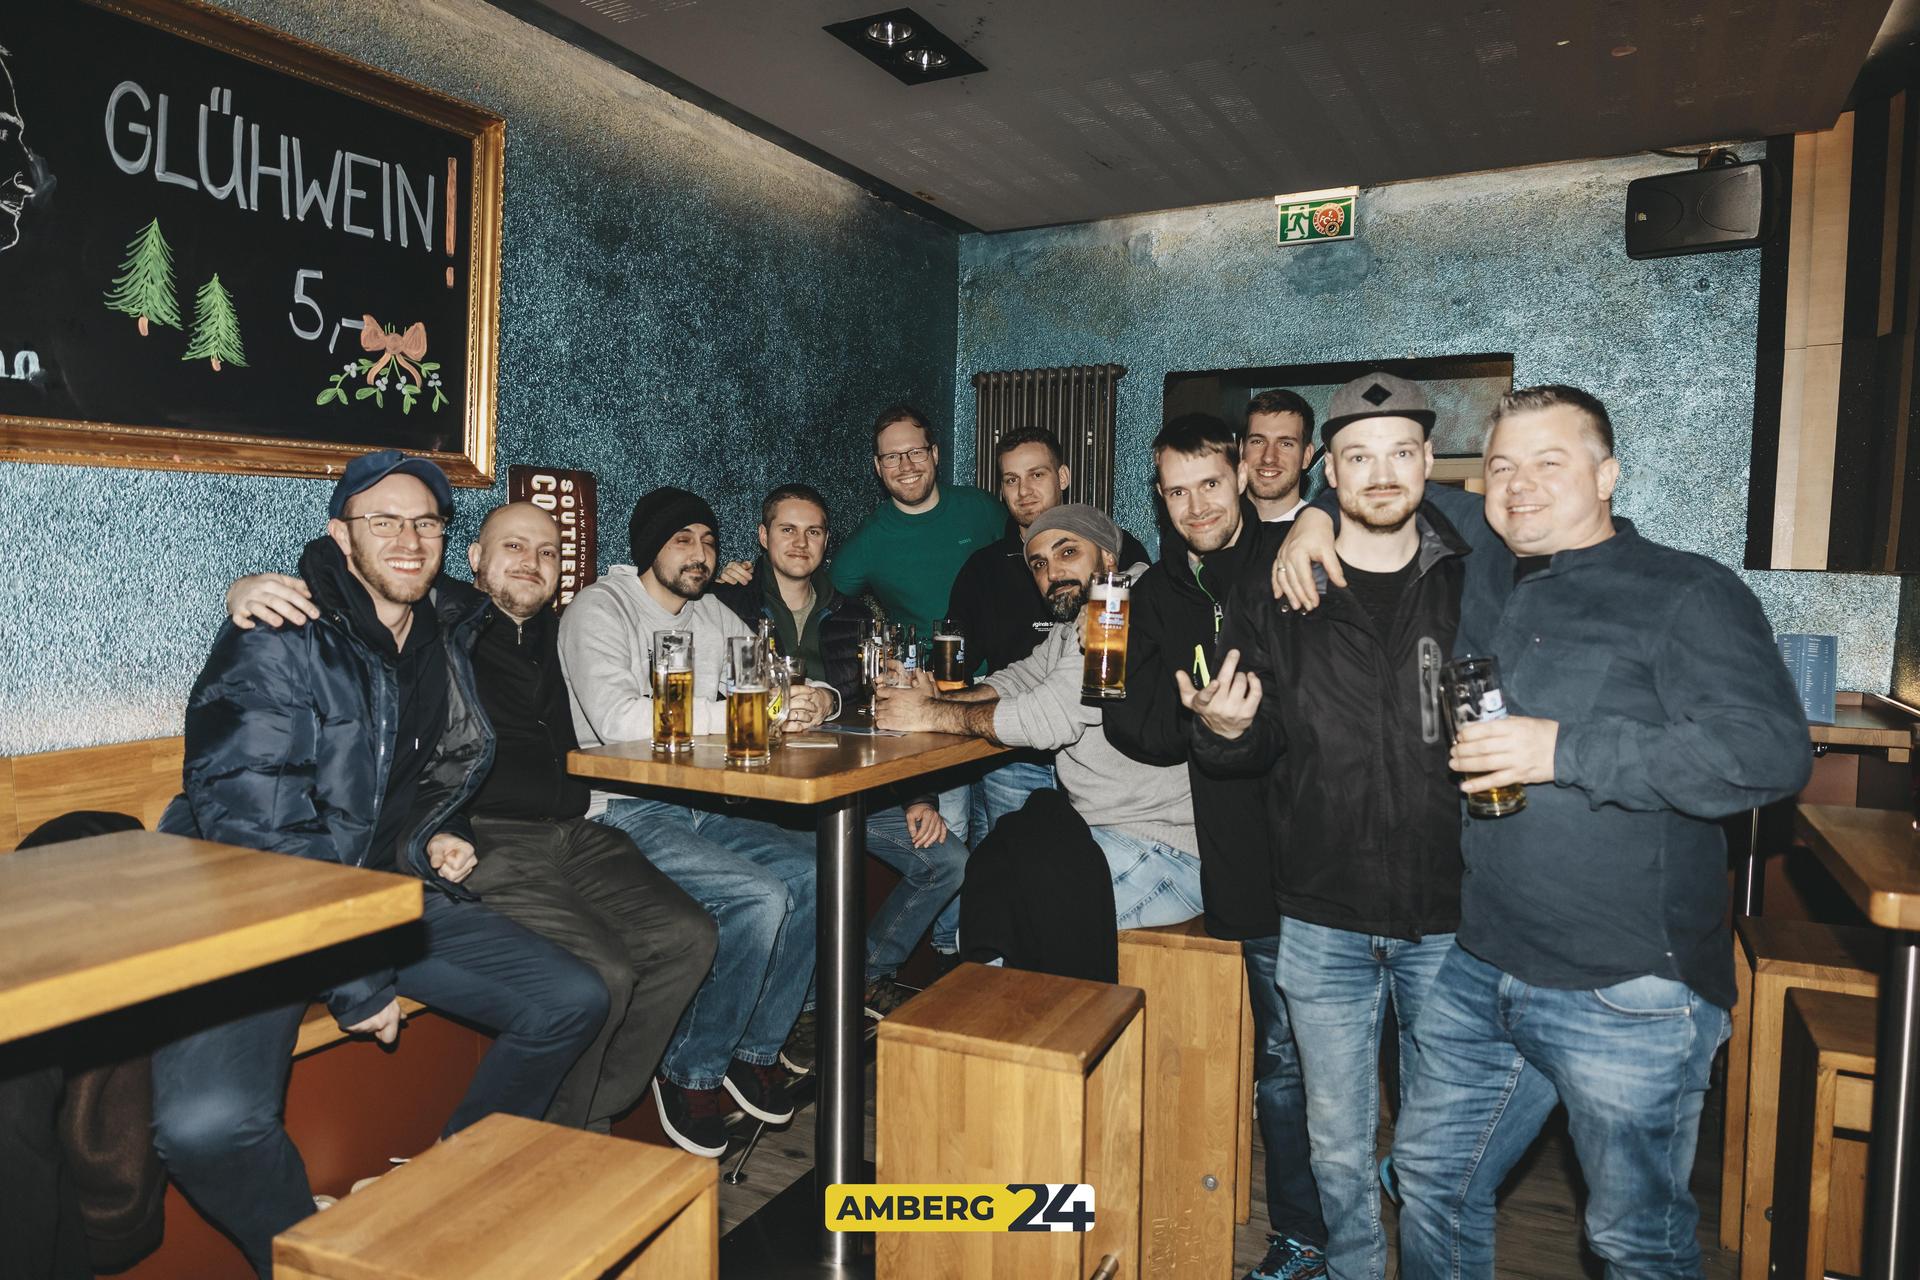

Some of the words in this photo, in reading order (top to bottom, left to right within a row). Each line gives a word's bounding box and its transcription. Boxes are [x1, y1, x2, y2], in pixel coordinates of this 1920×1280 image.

[104, 80, 458, 289] GLÜHWEIN!
[560, 478, 577, 606] SOUTHERN
[579, 532, 587, 577] HERON'S
